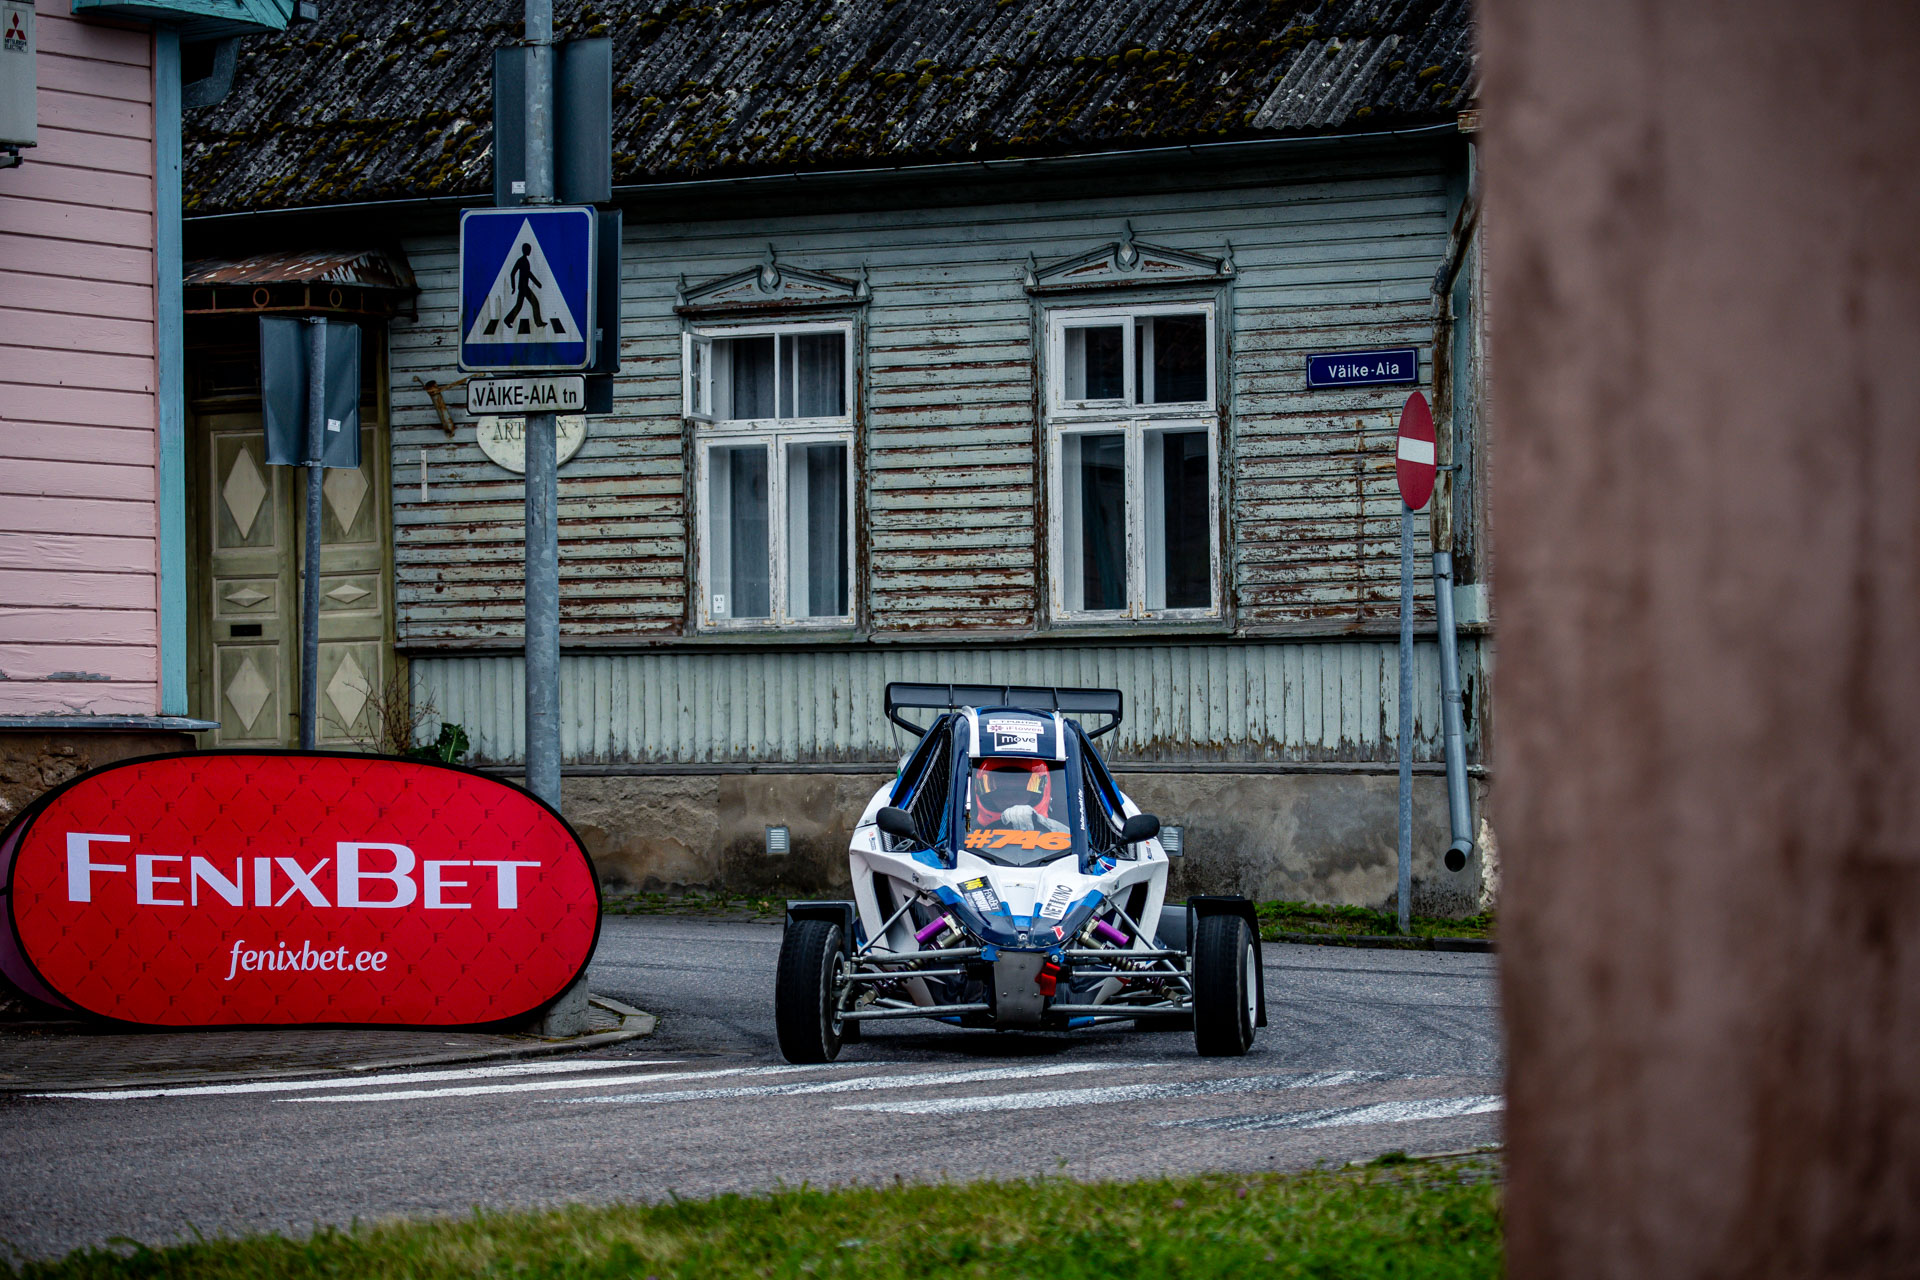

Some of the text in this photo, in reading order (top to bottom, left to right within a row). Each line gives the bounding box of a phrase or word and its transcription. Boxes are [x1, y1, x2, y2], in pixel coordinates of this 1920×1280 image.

[475, 382, 577, 406] VÄIKE-AIA tn
[1001, 735, 1036, 744] move
[964, 829, 1072, 850] #746
[224, 940, 388, 980] fenixbet.ee
